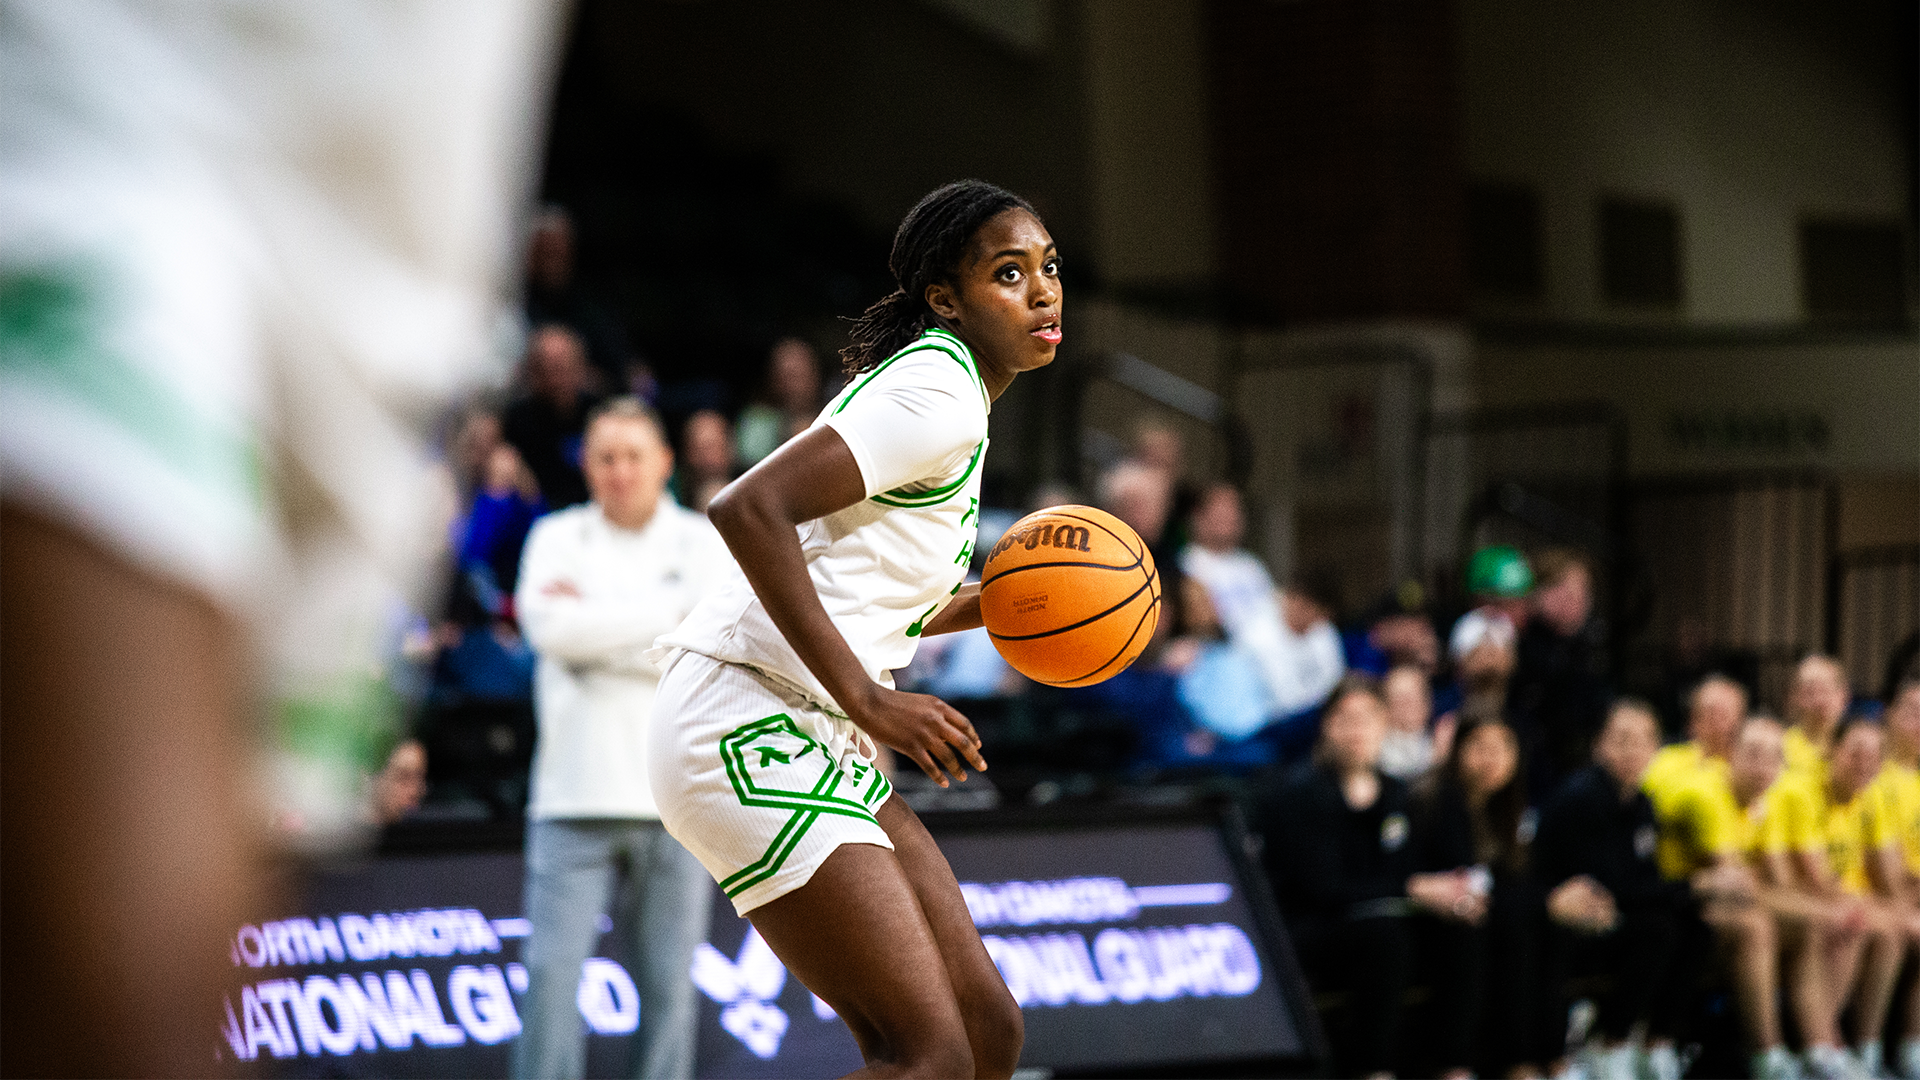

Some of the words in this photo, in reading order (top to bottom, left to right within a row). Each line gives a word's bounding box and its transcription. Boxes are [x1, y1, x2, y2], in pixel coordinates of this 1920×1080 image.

[988, 524, 1091, 564] Wilson
[1013, 594, 1048, 607] DAKOTA
[1016, 603, 1046, 615] NORTH
[230, 917, 346, 967] ORTH
[339, 909, 502, 962] DAKOTA
